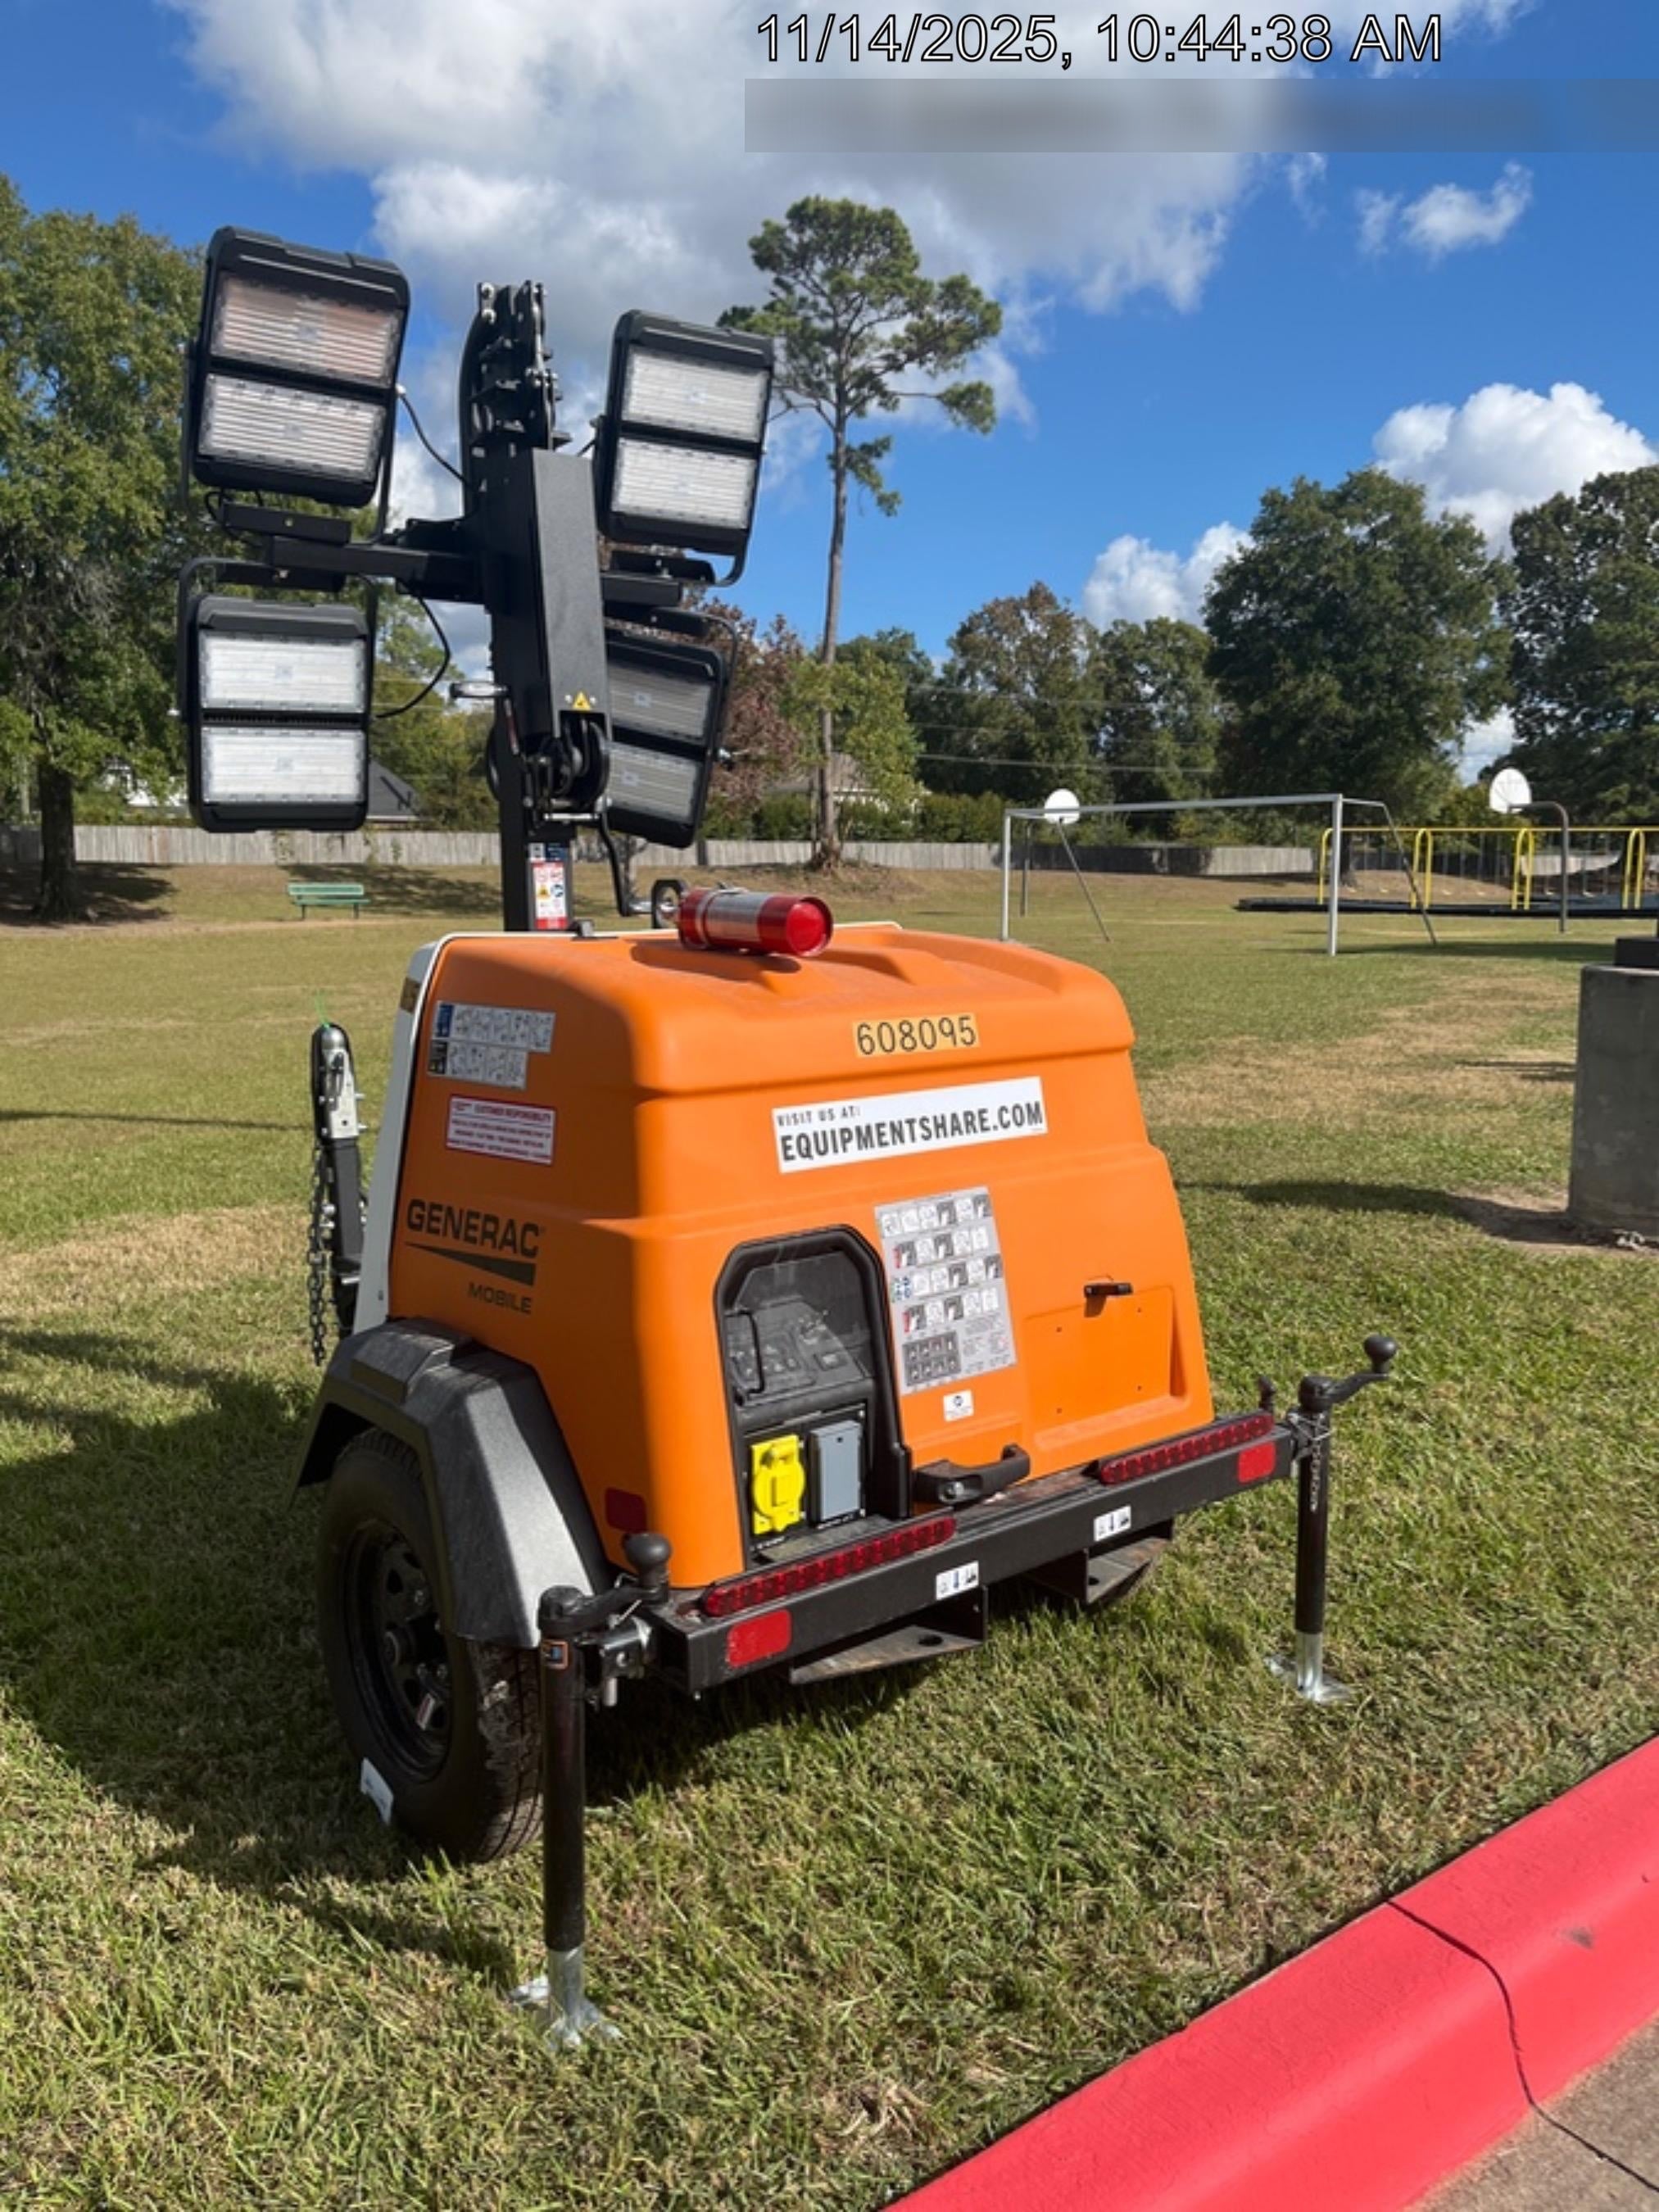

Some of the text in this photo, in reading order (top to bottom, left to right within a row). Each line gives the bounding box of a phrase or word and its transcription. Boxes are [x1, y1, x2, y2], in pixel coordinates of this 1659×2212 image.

[857, 1017, 976, 1054] 608095
[777, 1111, 812, 1126] VISIT
[819, 1108, 834, 1121] US
[781, 1101, 1042, 1161] EQUIPMENTSHARE.COM
[407, 1199, 539, 1258] GENERAC
[469, 1282, 532, 1314] MOBILE
